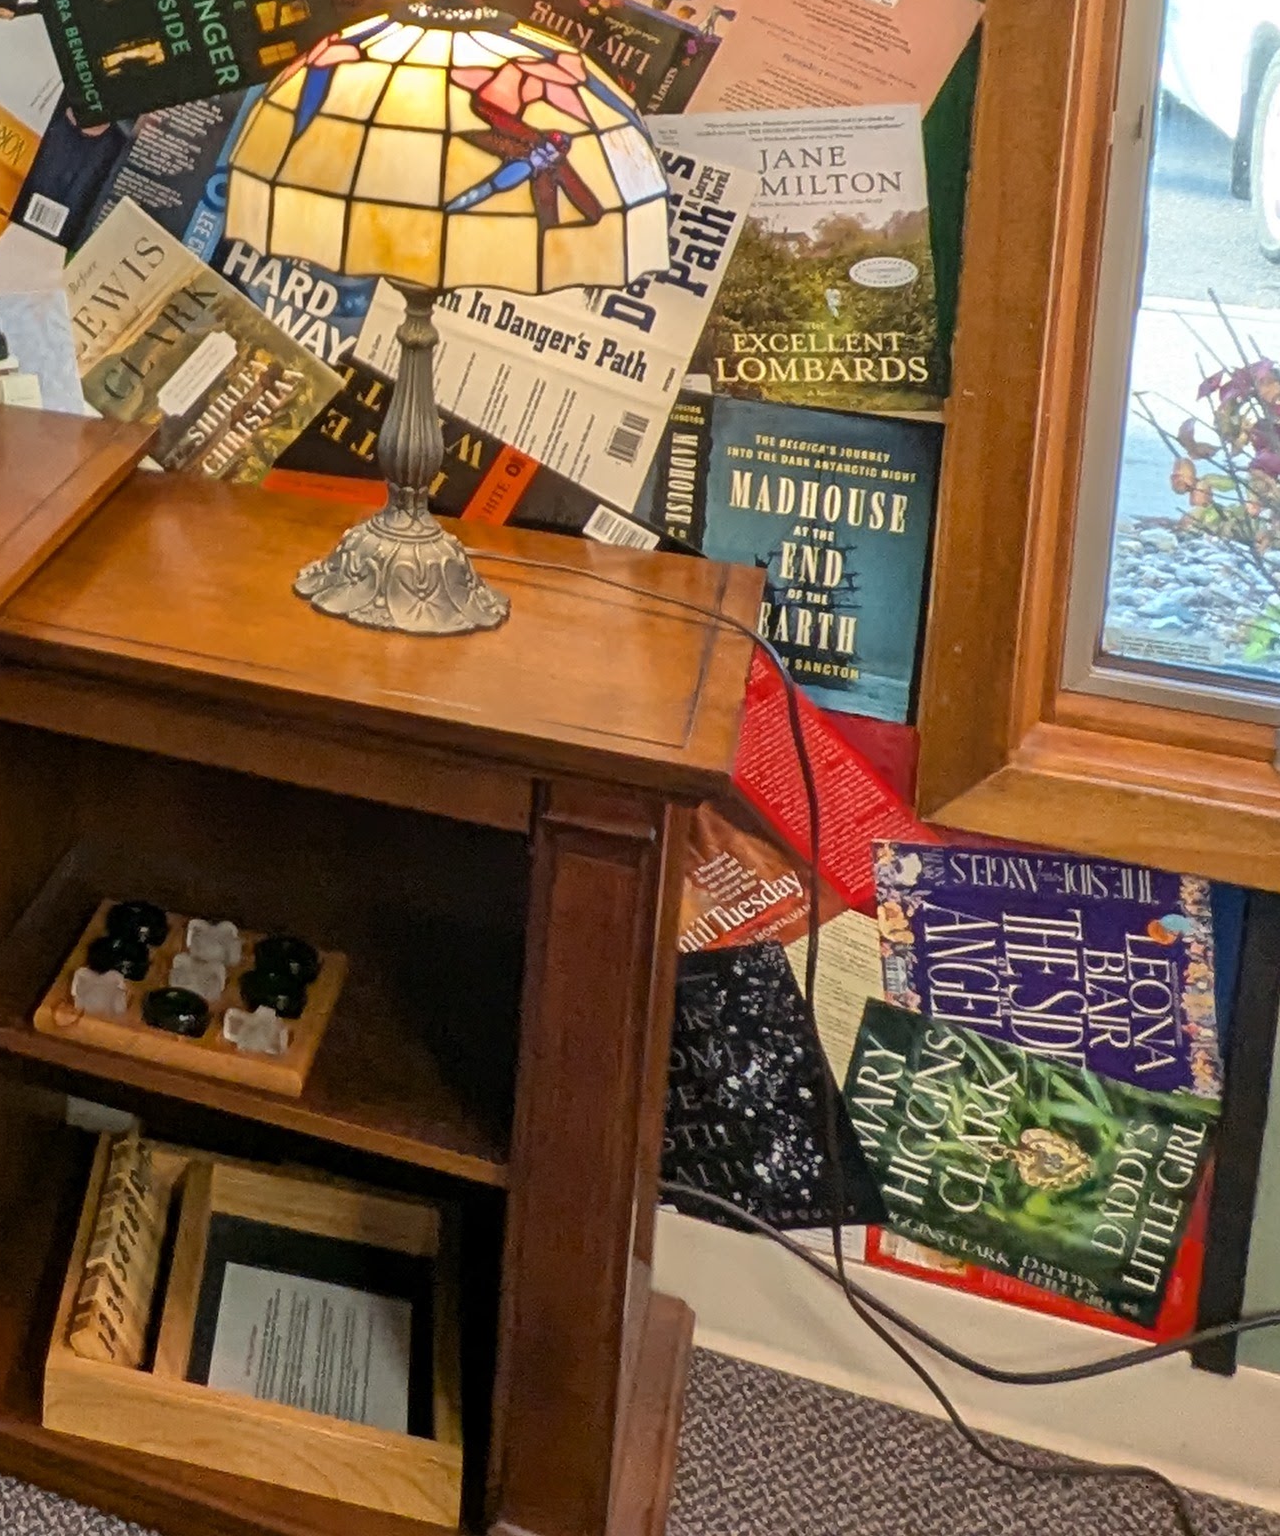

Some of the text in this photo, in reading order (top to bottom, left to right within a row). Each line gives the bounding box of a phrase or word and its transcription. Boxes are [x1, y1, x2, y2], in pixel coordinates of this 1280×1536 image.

[65, 26, 103, 112] BENEDICT
[758, 146, 847, 174] JANE
[223, 241, 338, 317] HARD
[264, 304, 358, 364] WAY
[467, 289, 647, 383] In Danger's Path
[733, 332, 904, 353] EXCELLENT
[717, 358, 928, 382] LOMBARDS
[730, 471, 907, 532] MADHOUSE
[794, 527, 833, 541] AT THE
[780, 545, 842, 588] END
[757, 603, 858, 653] EARTH
[1126, 932, 1177, 1072] LEONA
[851, 1034, 907, 1162] MARY
[883, 1026, 967, 1205] HIGGINS
[939, 1071, 1018, 1214] CLARK
